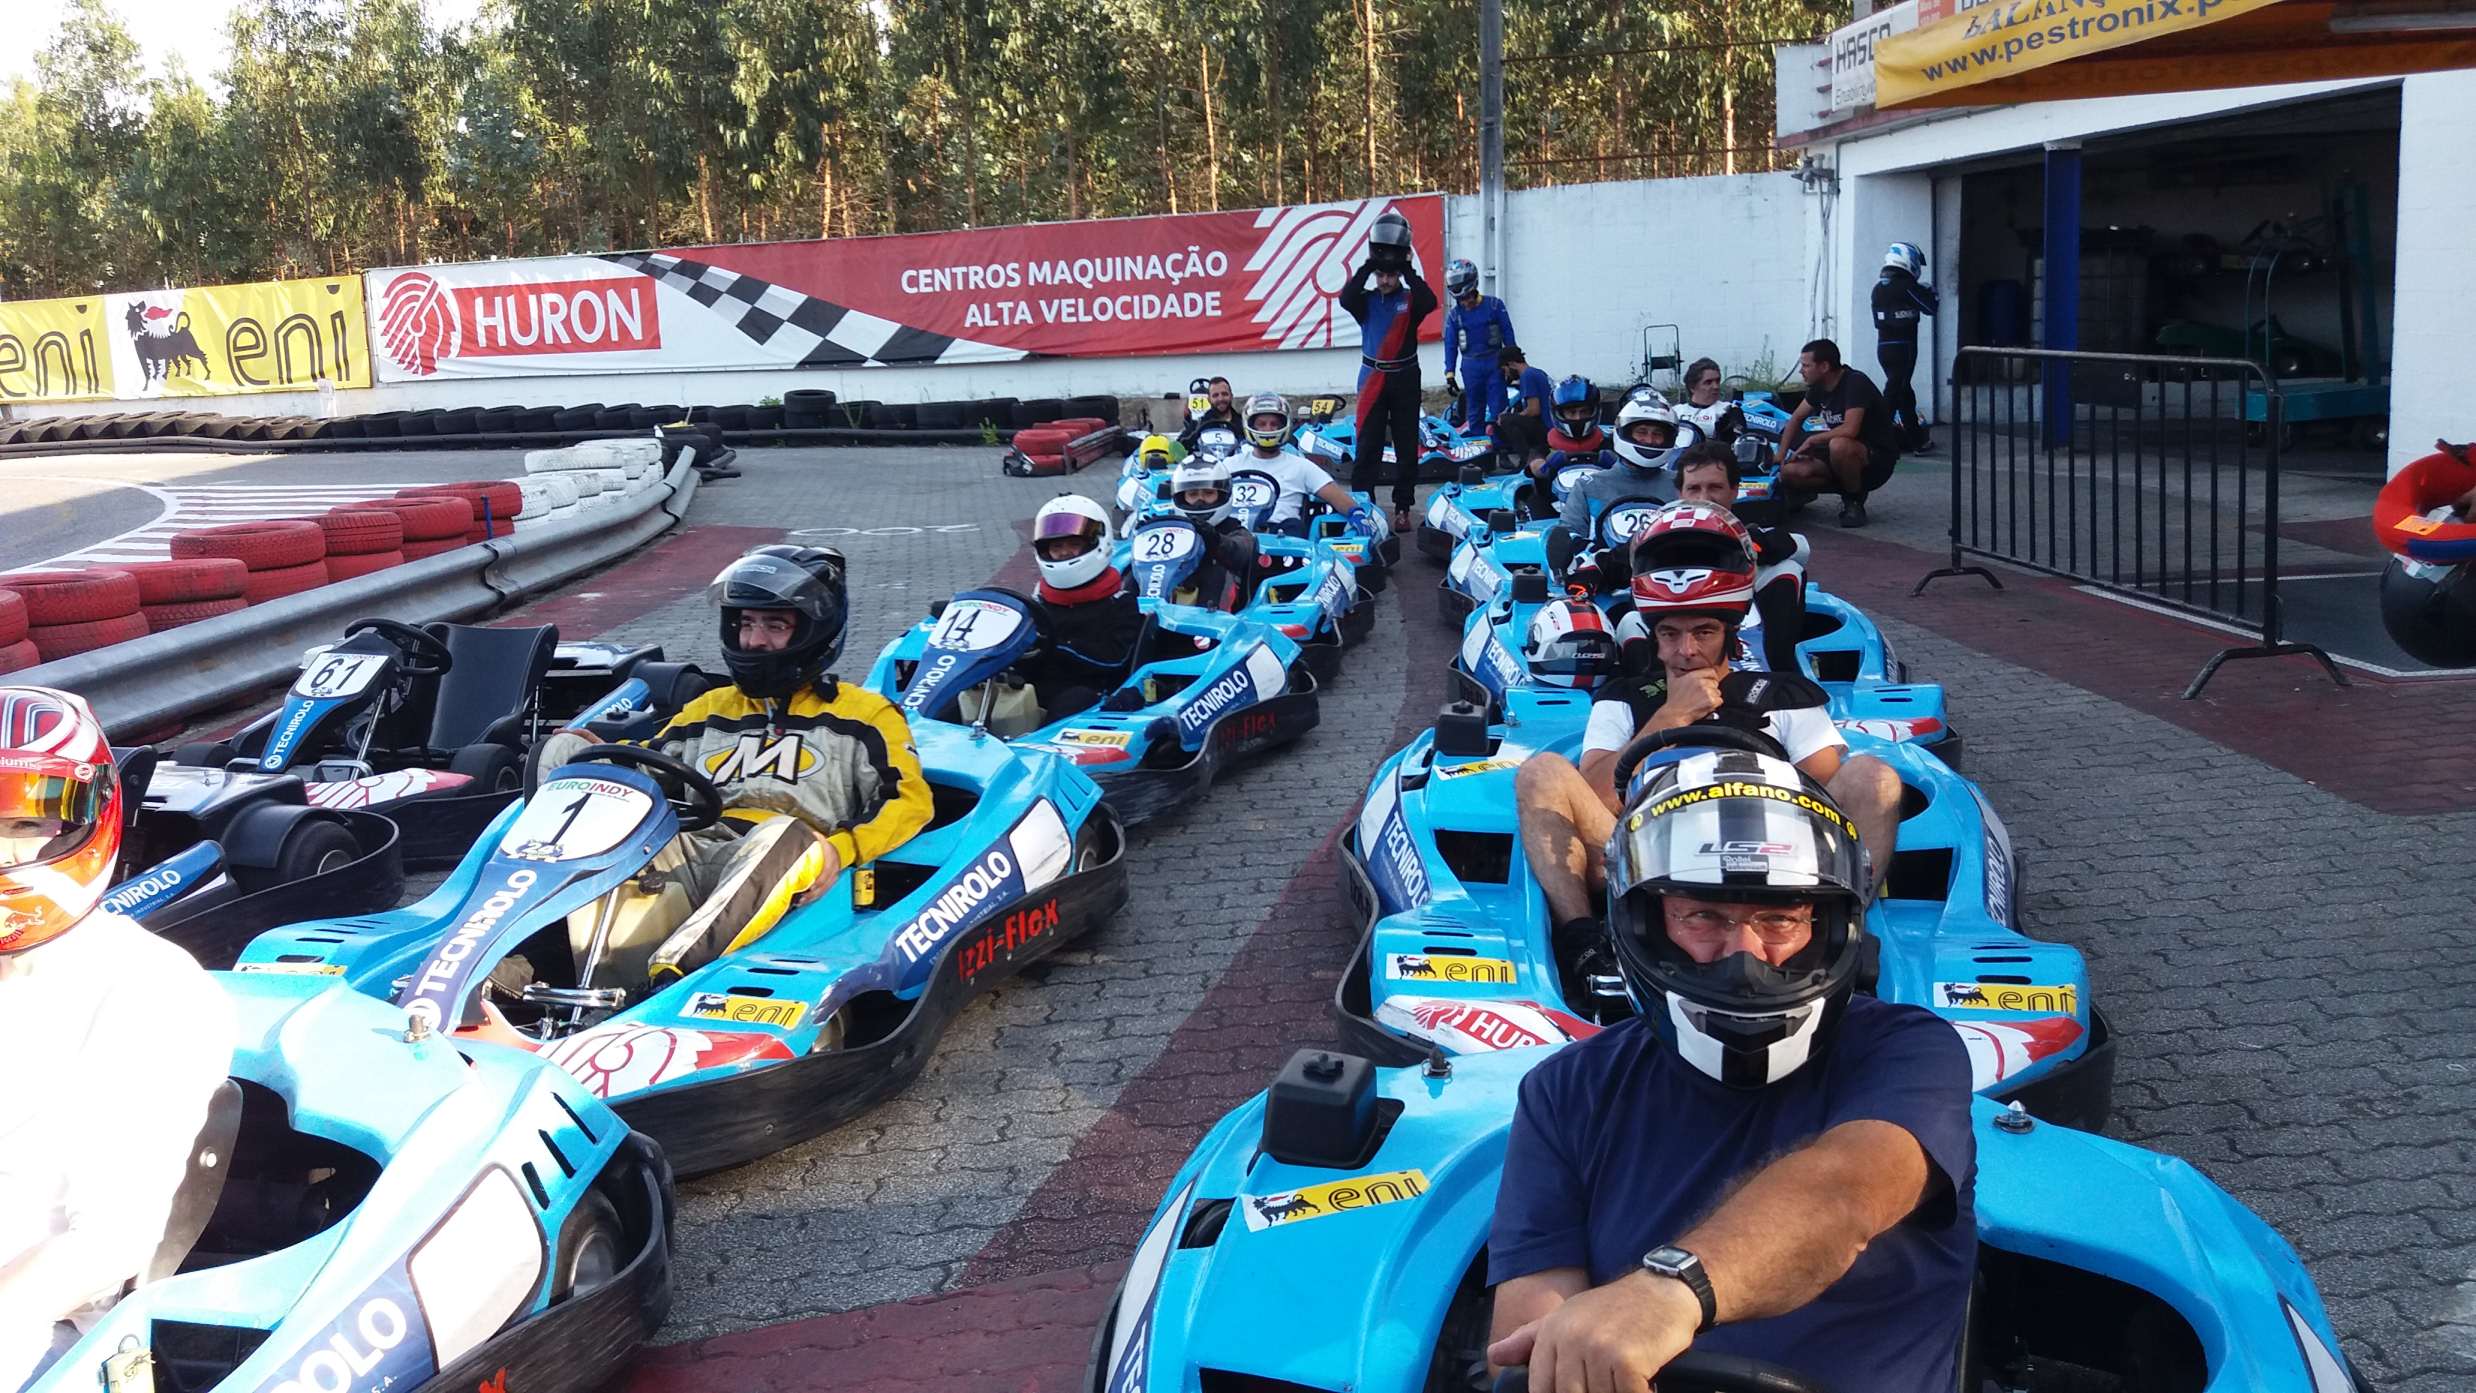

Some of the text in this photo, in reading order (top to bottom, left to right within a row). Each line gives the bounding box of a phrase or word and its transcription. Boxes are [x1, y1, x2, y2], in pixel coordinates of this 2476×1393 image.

[1921, 0, 2241, 82] www.pestronix.p
[900, 245, 1229, 295] CENTROS MAQUINAÇÃO
[474, 287, 644, 348] HURON
[964, 290, 1223, 328] ALTA VELOCIDADE
[0, 304, 100, 398] eni
[226, 284, 351, 387] eni
[1191, 399, 1206, 409] 51
[1313, 401, 1329, 412] 54
[1214, 432, 1223, 443] 5
[1235, 485, 1257, 502] 32
[1145, 532, 1175, 556] 28
[1624, 513, 1652, 535] 26
[941, 608, 981, 641] 14
[310, 657, 365, 690] 61
[1180, 670, 1249, 731] TECNIROLO
[272, 700, 315, 755] TECNIROLO
[547, 781, 634, 798] EUROINDY
[1651, 781, 1842, 826] www.alfano.com
[560, 792, 593, 846] 1
[1697, 841, 1793, 855] LS2
[99, 869, 182, 916] CNIROLO
[895, 851, 1012, 964] TECNIROLO
[415, 868, 538, 997] TECNIROLO
[1445, 959, 1510, 983] eni
[732, 1000, 800, 1028] eni
[1328, 1171, 1422, 1212] eni
[268, 1297, 408, 1393] OLO
